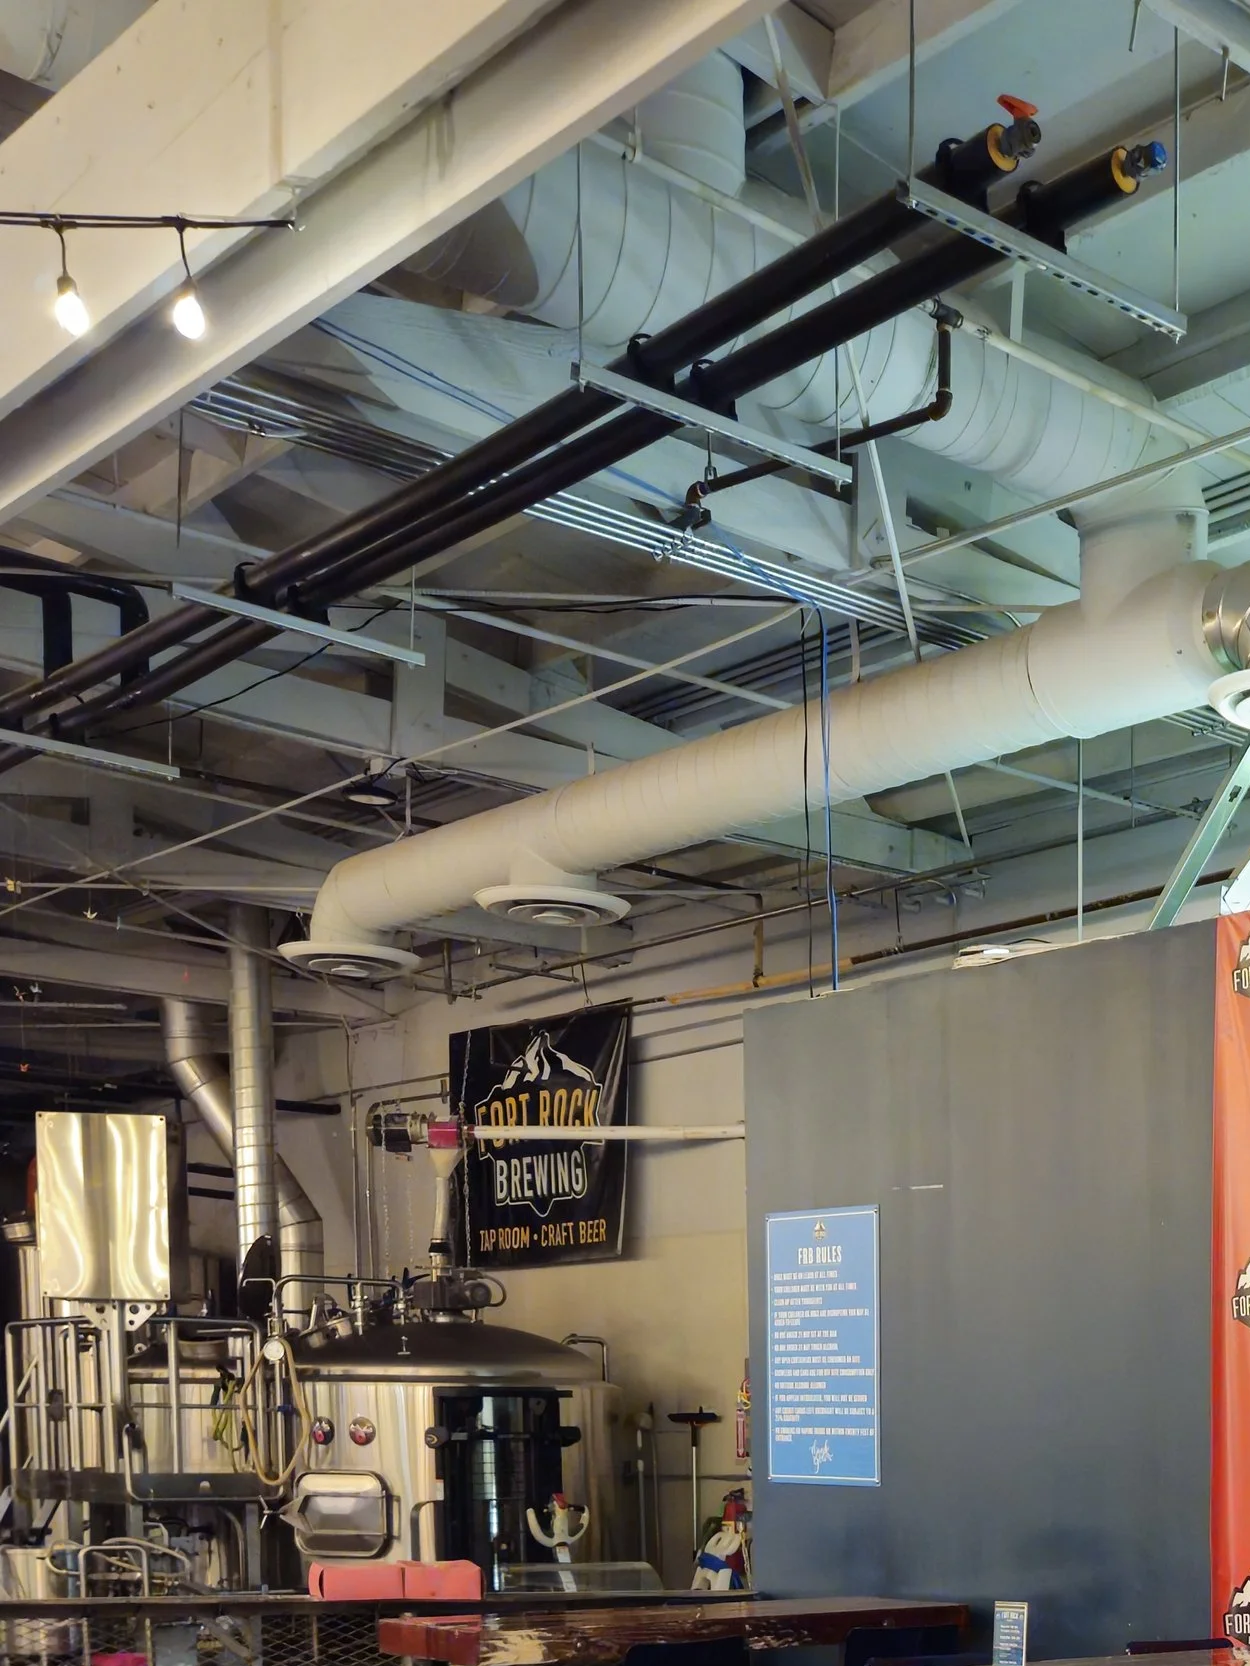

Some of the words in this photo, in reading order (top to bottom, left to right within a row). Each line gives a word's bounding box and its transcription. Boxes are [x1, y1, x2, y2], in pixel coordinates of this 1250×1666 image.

[476, 1091, 531, 1154] FORT
[538, 1087, 599, 1127] ROCK
[496, 1149, 584, 1200] BREWING
[479, 1229, 497, 1252] TAP
[497, 1224, 531, 1250] ROOM
[541, 1221, 574, 1247] CRAFT
[579, 1218, 607, 1244] BEER
[798, 1247, 814, 1265] FRB
[815, 1245, 842, 1264] RULES
